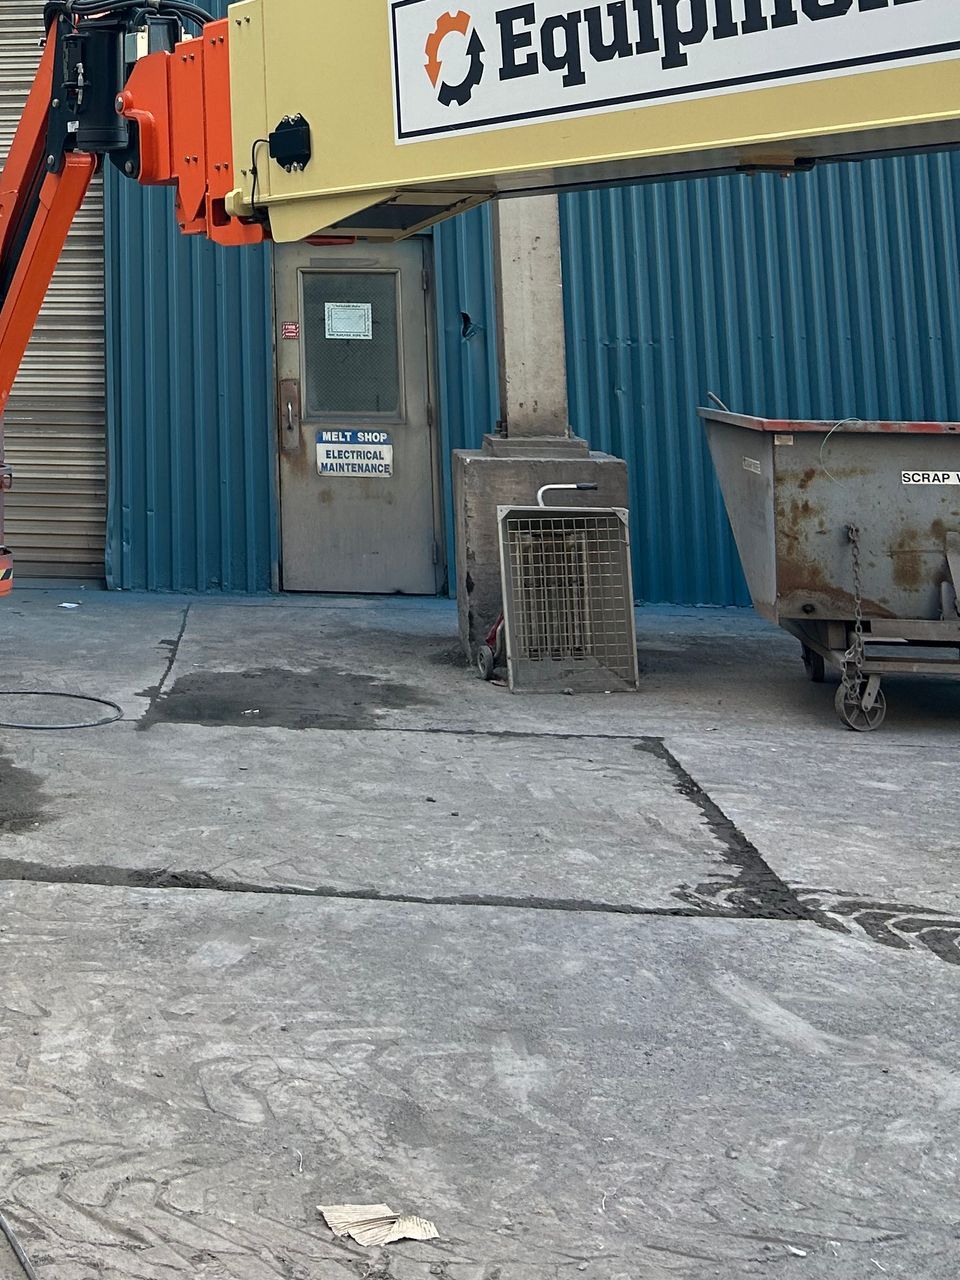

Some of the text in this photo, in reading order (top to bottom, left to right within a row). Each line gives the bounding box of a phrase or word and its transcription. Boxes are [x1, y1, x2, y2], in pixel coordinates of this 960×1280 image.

[322, 431, 388, 443] MELT SHOP
[325, 449, 385, 460] ELECTRICAL
[320, 462, 391, 474] MAINTENANCE
[902, 472, 951, 483] SCRAP
